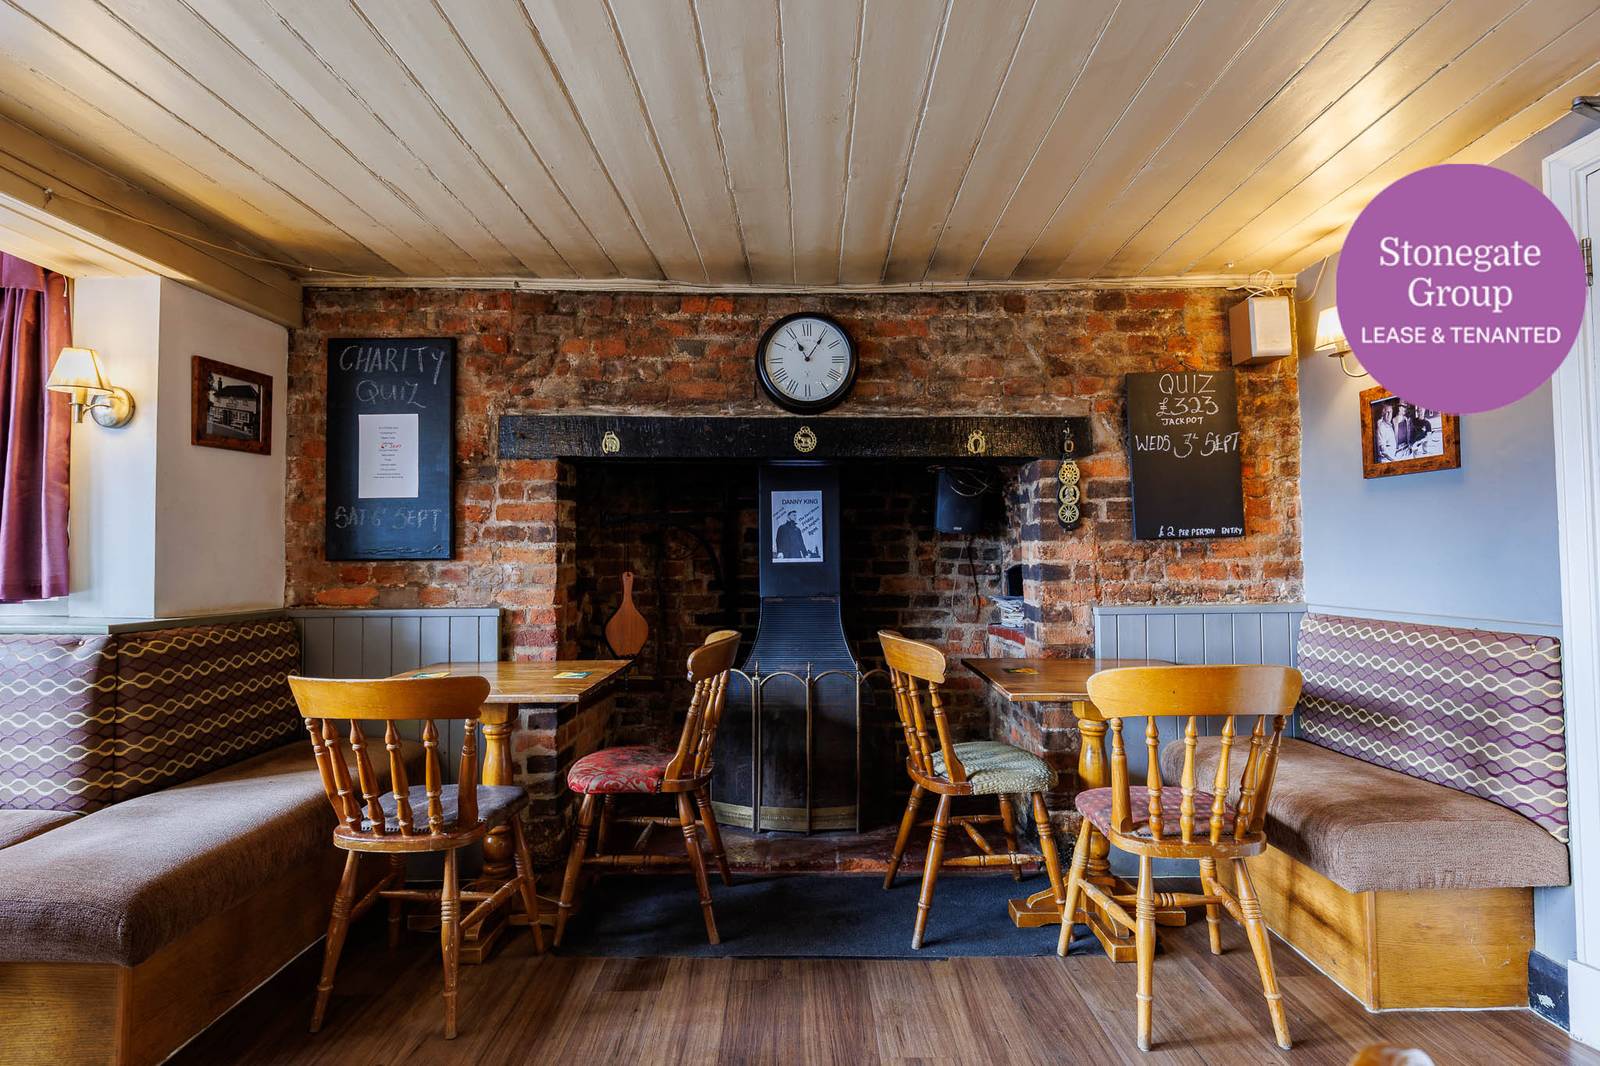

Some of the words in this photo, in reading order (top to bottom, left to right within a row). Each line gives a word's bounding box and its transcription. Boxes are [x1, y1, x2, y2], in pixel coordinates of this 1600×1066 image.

[339, 346, 446, 385] CHARITY
[355, 379, 427, 409] QUIZ
[1159, 373, 1217, 395] QUIZ
[1155, 395, 1220, 417] £323
[1161, 416, 1204, 426] JACKPOT
[1135, 434, 1171, 452] WEDS
[1200, 431, 1240, 457] SEPT
[335, 505, 368, 529] SAT
[392, 506, 442, 533] SEPT
[1191, 527, 1216, 536] PERSON
[1221, 526, 1243, 535] ENTRY
